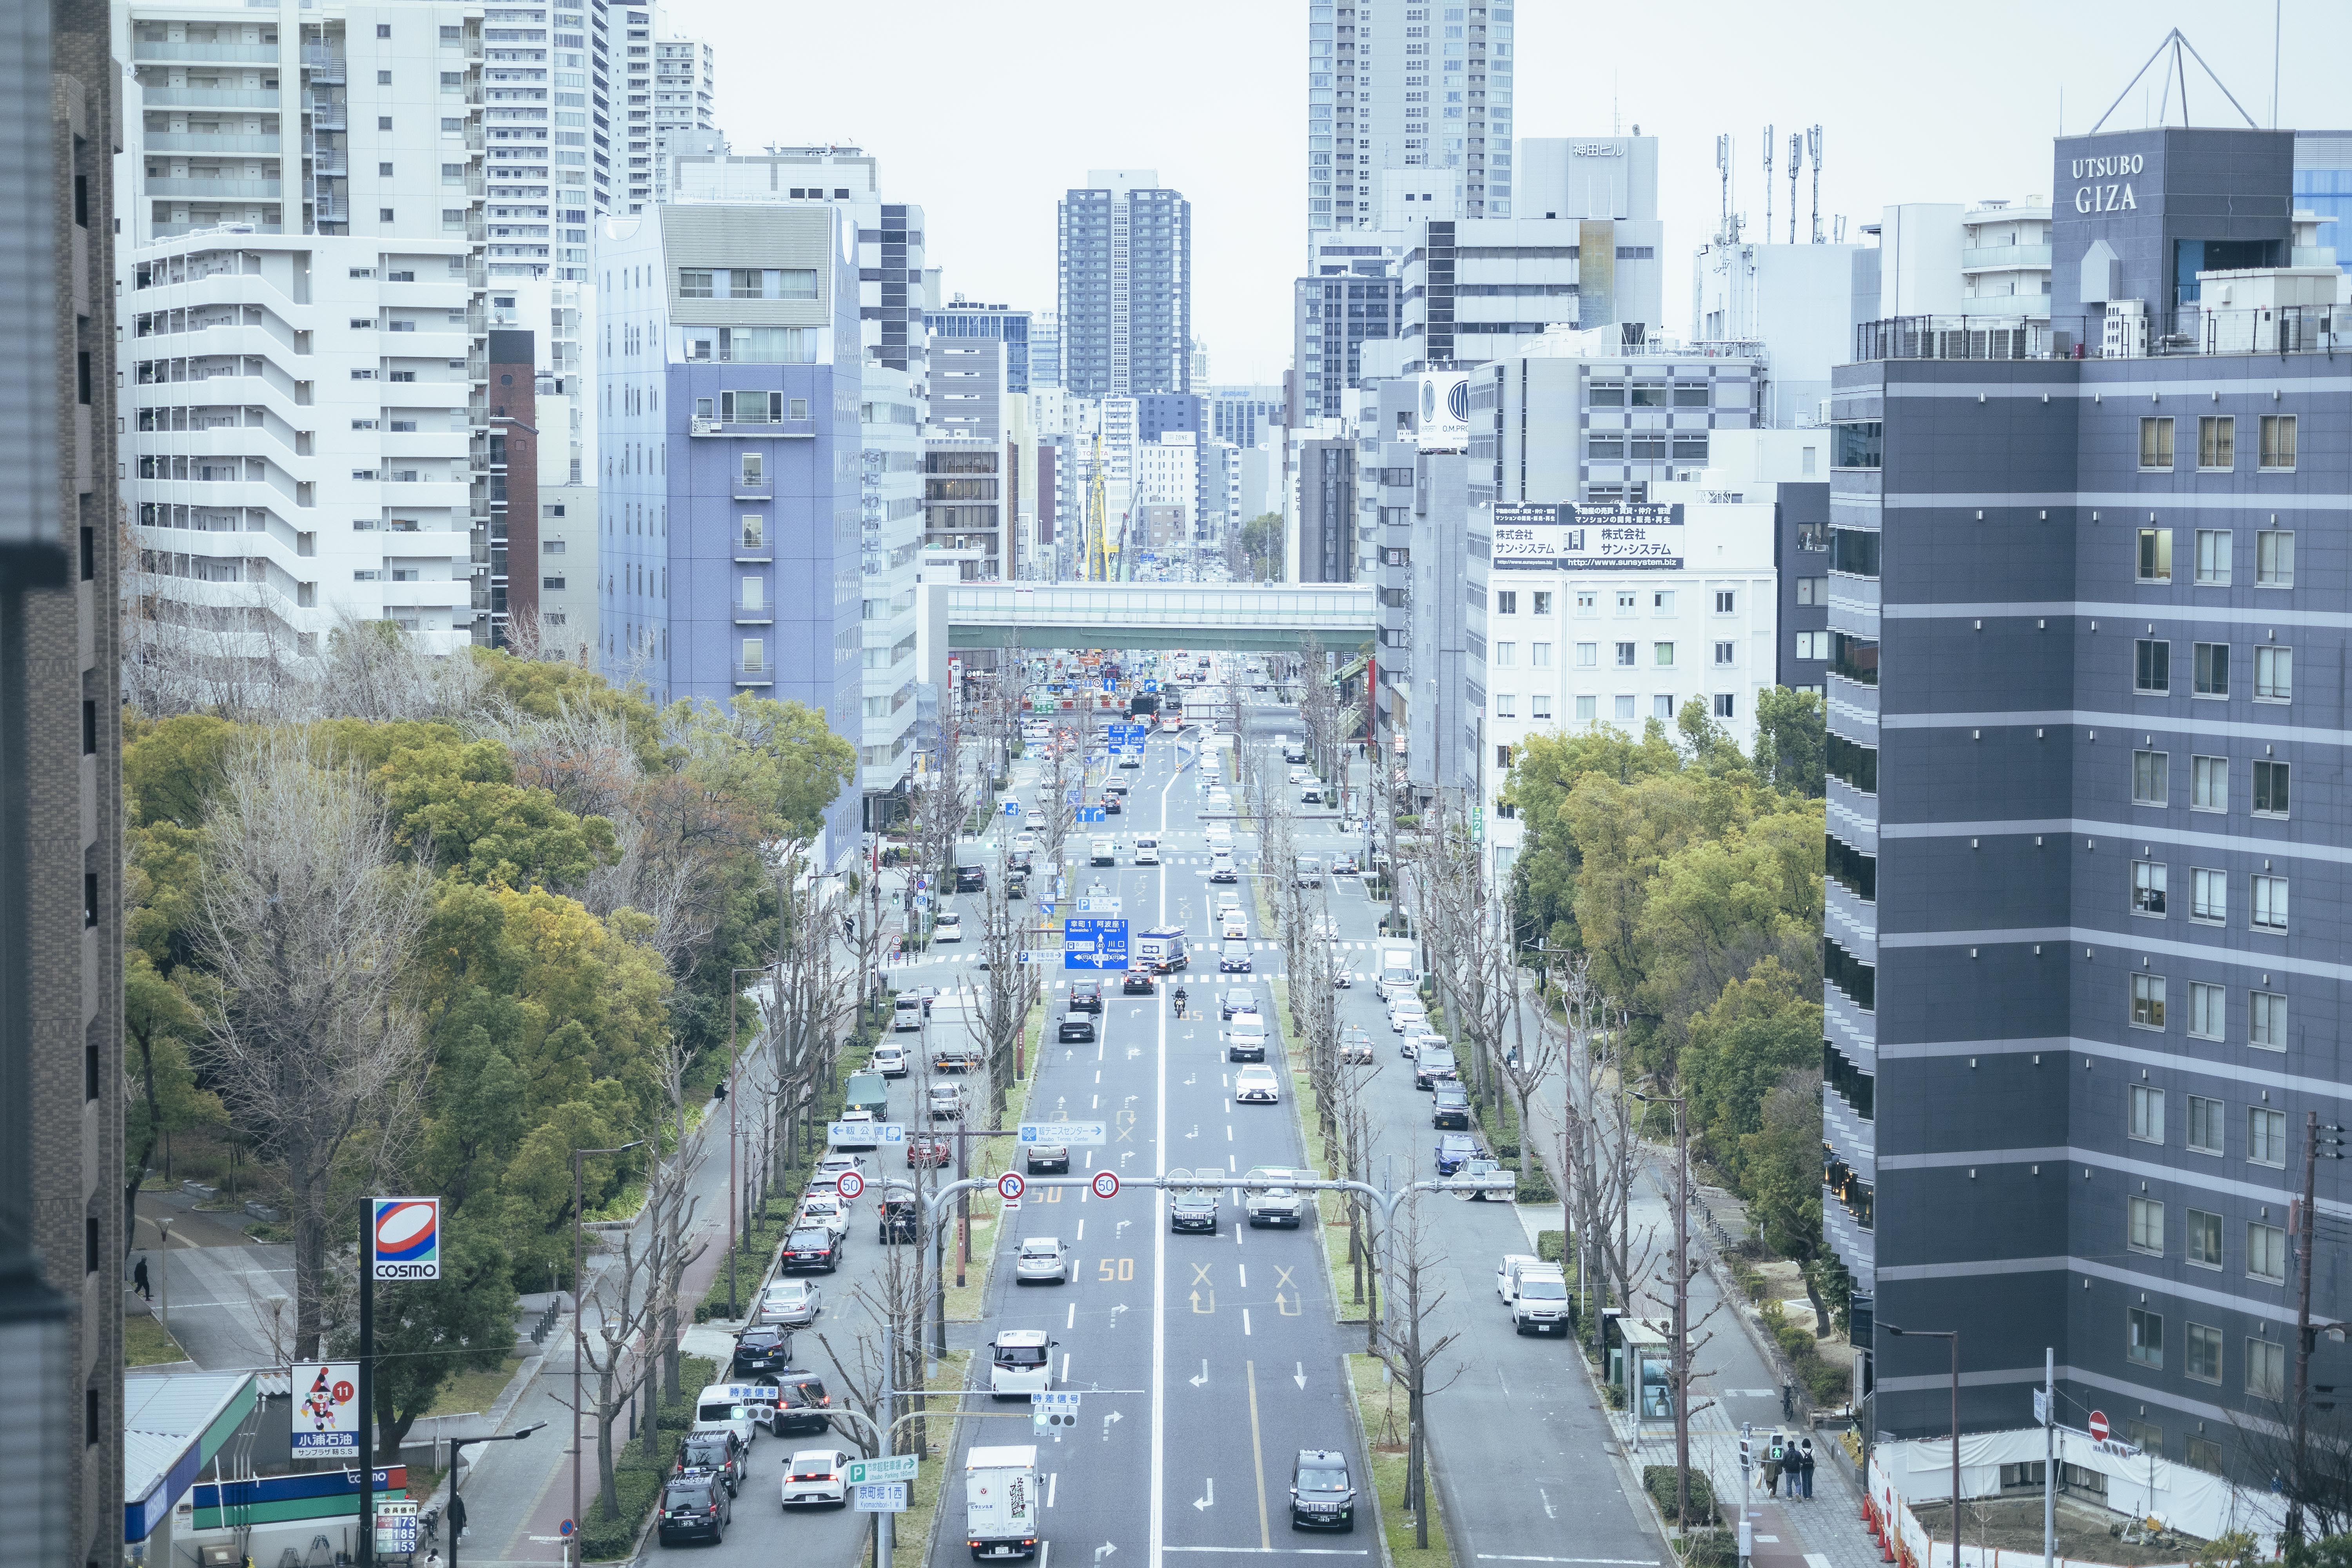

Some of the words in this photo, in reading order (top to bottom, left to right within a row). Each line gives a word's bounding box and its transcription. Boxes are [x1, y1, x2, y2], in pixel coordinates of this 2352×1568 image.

[1573, 143, 1624, 156] 神田ビル
[2073, 154, 2143, 179] UTSUBO
[2076, 183, 2137, 214] GIZA
[865, 449, 880, 575] なにわ筋ビル
[1496, 529, 1533, 540] 株式会社
[1601, 528, 1646, 540] 株式会社
[1496, 543, 1555, 554] サン・システム
[1601, 543, 1671, 555] サン・システム
[1568, 558, 1677, 568] http://www.sunsystem.biz
[1081, 900, 1088, 909] P
[846, 1126, 884, 1136] 靱公園
[1038, 1126, 1089, 1135] 靱テニスセンター
[843, 1180, 858, 1191] 50
[1099, 1180, 1113, 1191] 50
[1029, 1187, 1062, 1203] 50
[376, 1264, 436, 1278] COSMO
[1099, 1258, 1134, 1281] 50
[337, 1387, 348, 1396] 11
[730, 1388, 777, 1397] 時差信号
[1033, 1394, 1079, 1404] 時差信号
[299, 1434, 352, 1446] 小浦石油
[867, 1459, 901, 1472] 市営靱駐車場
[348, 1472, 386, 1483] COMO
[854, 1466, 862, 1480] P
[860, 1487, 902, 1499] 京町堀1西
[1013, 1506, 1023, 1514] 35K
[394, 1517, 416, 1528] 173
[393, 1529, 416, 1539] 185
[394, 1541, 416, 1552] 153
